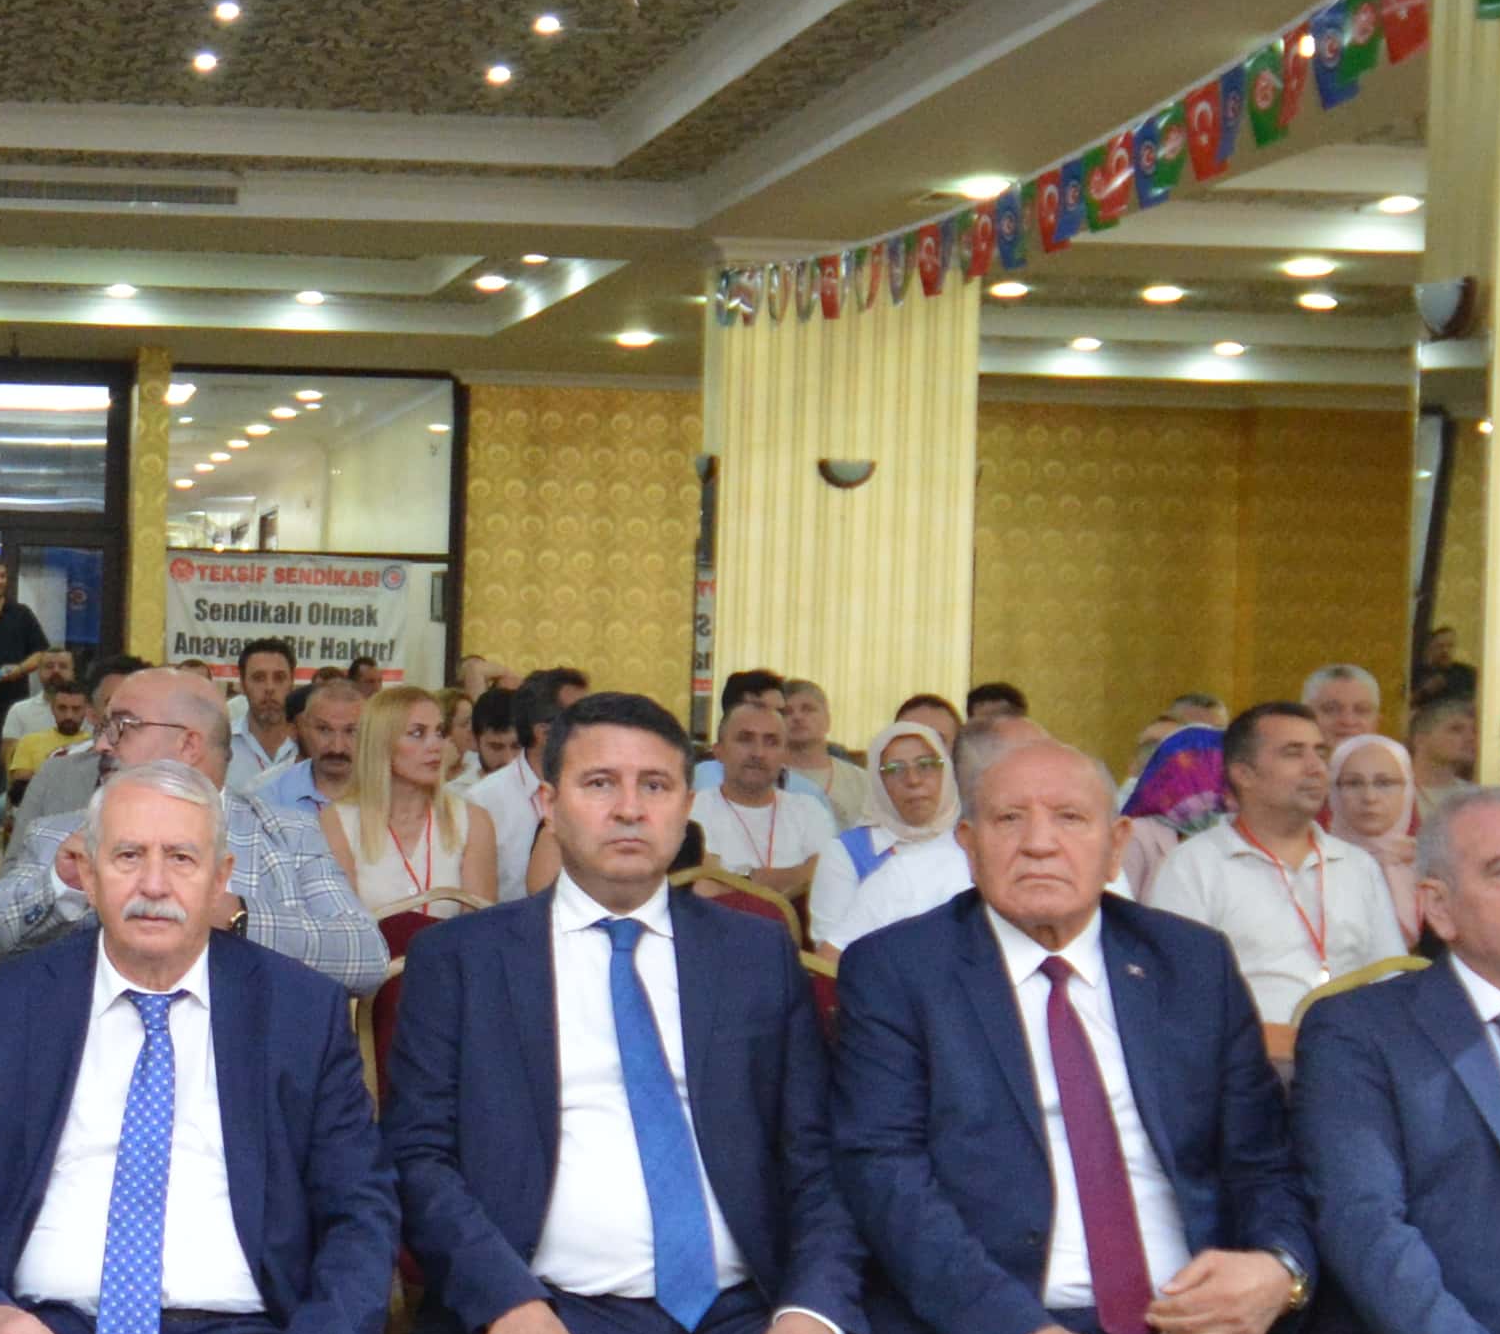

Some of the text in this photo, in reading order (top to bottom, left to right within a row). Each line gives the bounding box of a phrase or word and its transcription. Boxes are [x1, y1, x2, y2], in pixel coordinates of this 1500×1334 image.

[195, 562, 380, 588] TEKSİF SENDİKASI
[194, 598, 378, 628] Sendikalı Olmak
